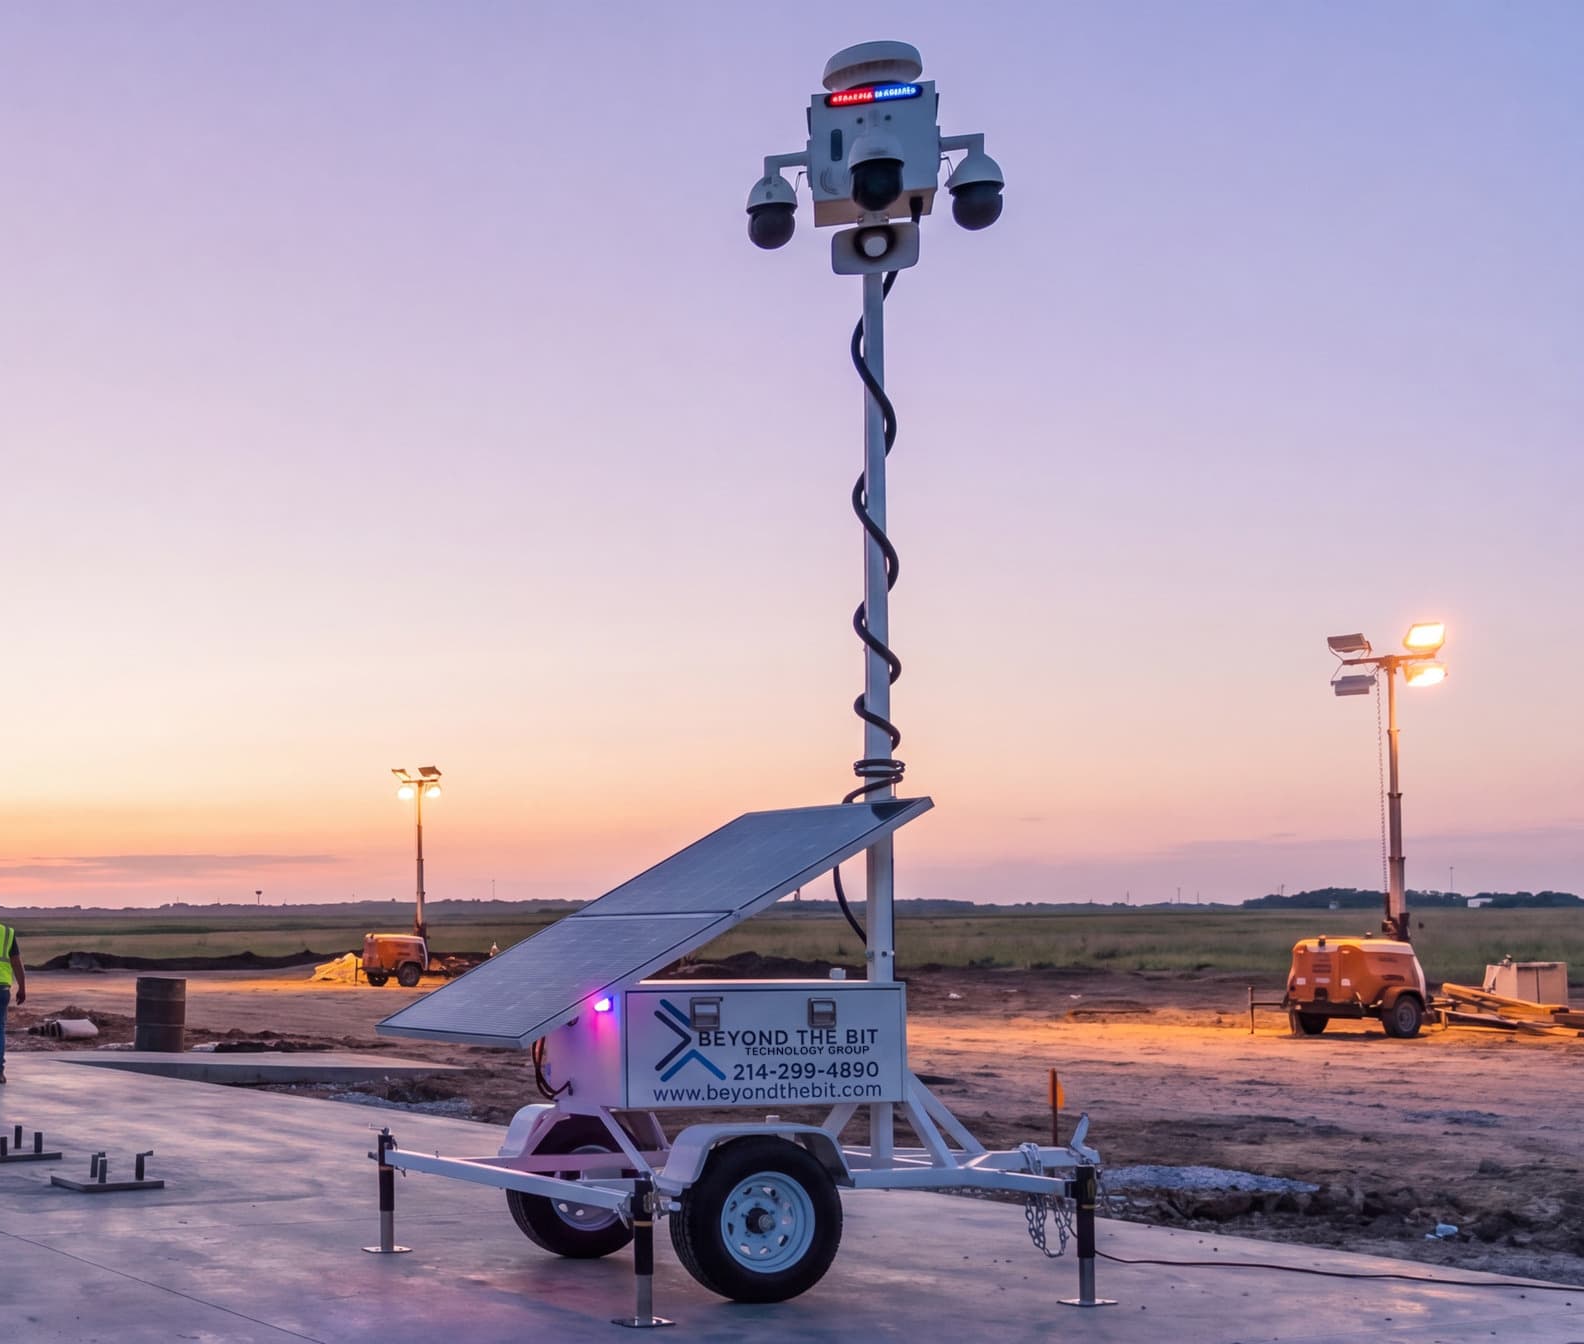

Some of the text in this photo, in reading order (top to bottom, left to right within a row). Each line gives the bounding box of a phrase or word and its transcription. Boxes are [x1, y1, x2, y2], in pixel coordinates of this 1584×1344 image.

[699, 1029, 879, 1047] BEYOND THE BIT
[745, 1045, 870, 1056] TECHNOLOGY GROUP
[733, 1061, 879, 1081] 214-299-4890
[653, 1082, 882, 1103] www.beyondthebit.com
